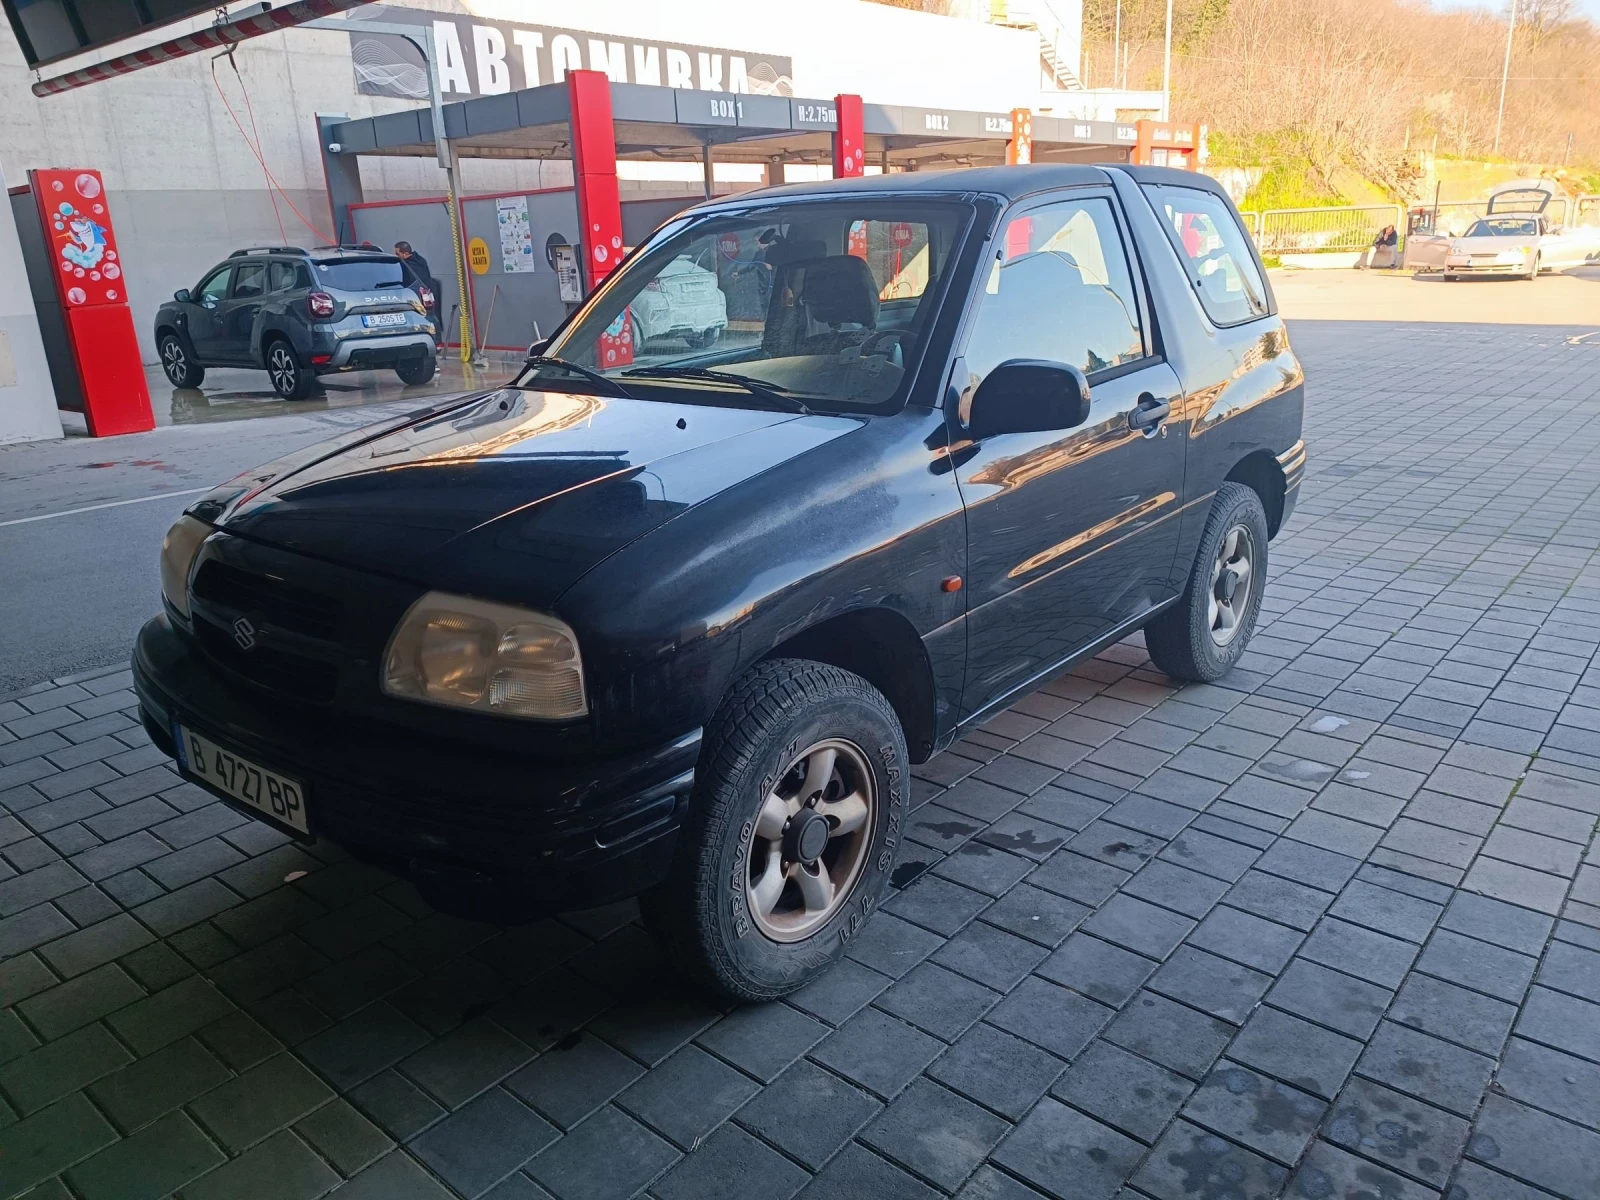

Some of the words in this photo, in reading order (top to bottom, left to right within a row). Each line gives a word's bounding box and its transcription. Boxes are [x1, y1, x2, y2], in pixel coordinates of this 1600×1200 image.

[433, 20, 748, 95] АВТОМИВКА
[711, 99, 735, 118] BOX
[737, 103, 743, 118] 1
[798, 105, 837, 123] H:2.75m
[925, 114, 942, 129] BOX
[943, 116, 949, 130] 2
[190, 735, 206, 774] B
[215, 751, 262, 804] 4727
[266, 775, 300, 821] BP
[878, 745, 901, 873] MAXXIS
[732, 820, 752, 939] BRAVO
